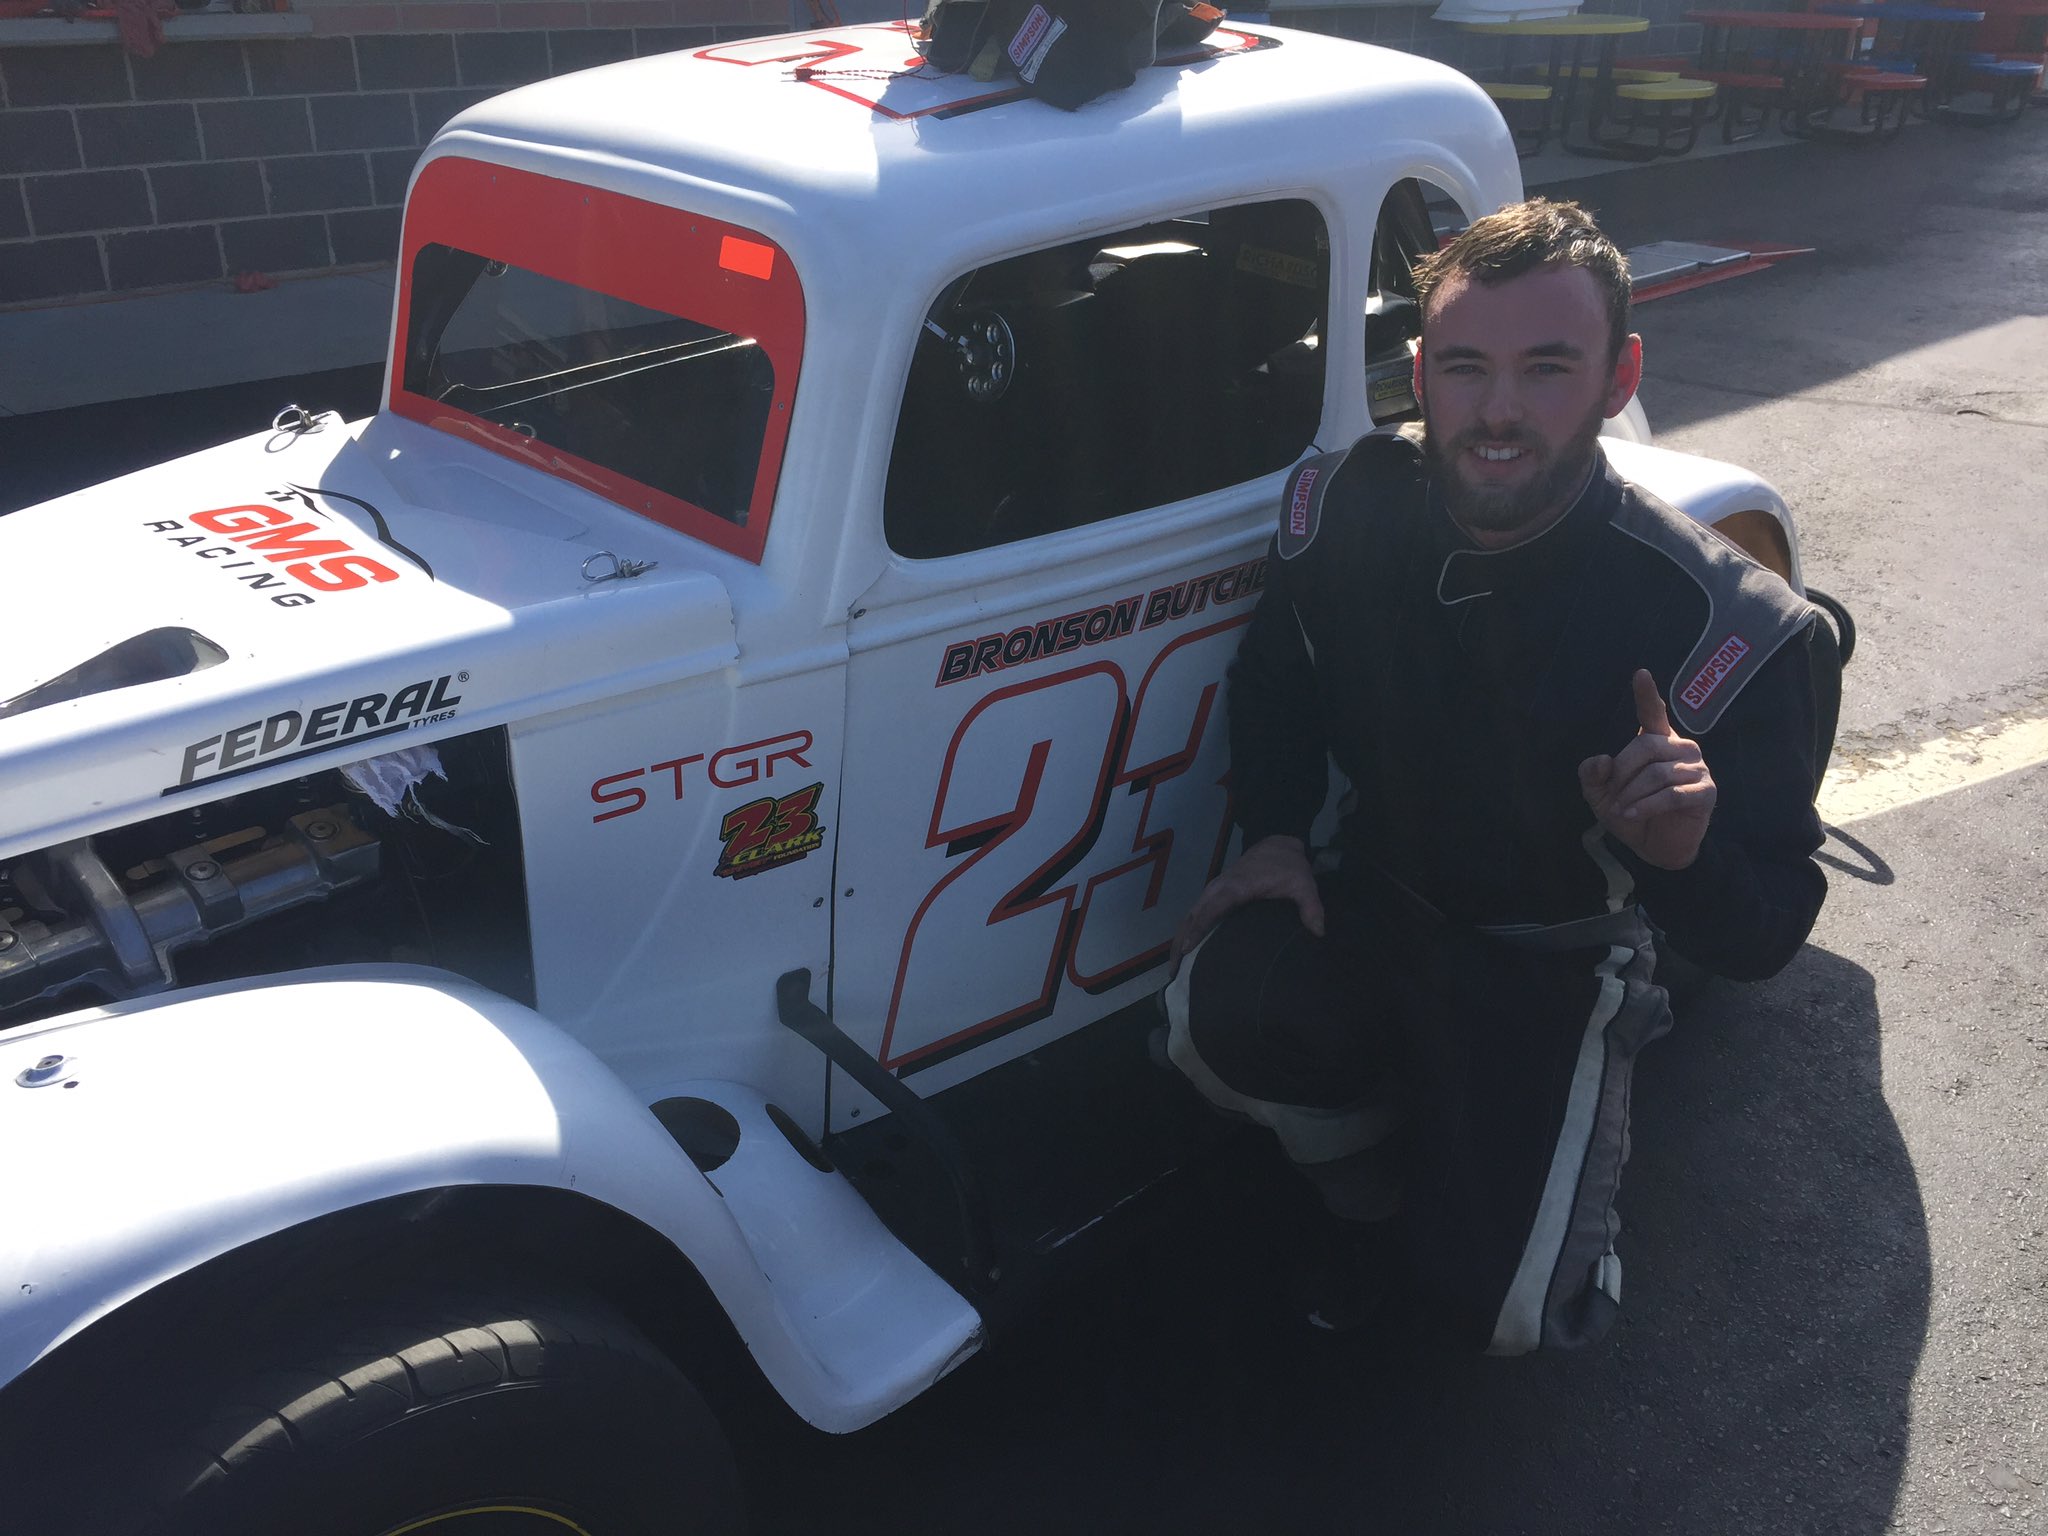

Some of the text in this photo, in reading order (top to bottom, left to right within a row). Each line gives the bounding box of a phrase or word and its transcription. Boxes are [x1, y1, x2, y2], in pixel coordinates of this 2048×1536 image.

[1013, 13, 1045, 60] SIMPSON
[1291, 470, 1317, 533] SIMPSON
[143, 521, 316, 608] RACING
[189, 504, 400, 592] GMS
[937, 598, 1141, 689] BRONSON
[1684, 638, 1747, 707] SIMPSON
[180, 674, 463, 785] FEDERAL
[412, 710, 456, 729] TYRES
[591, 730, 814, 824] STGR
[722, 785, 819, 859] 23
[732, 831, 821, 865] CLARK
[880, 613, 1250, 1078] 23
